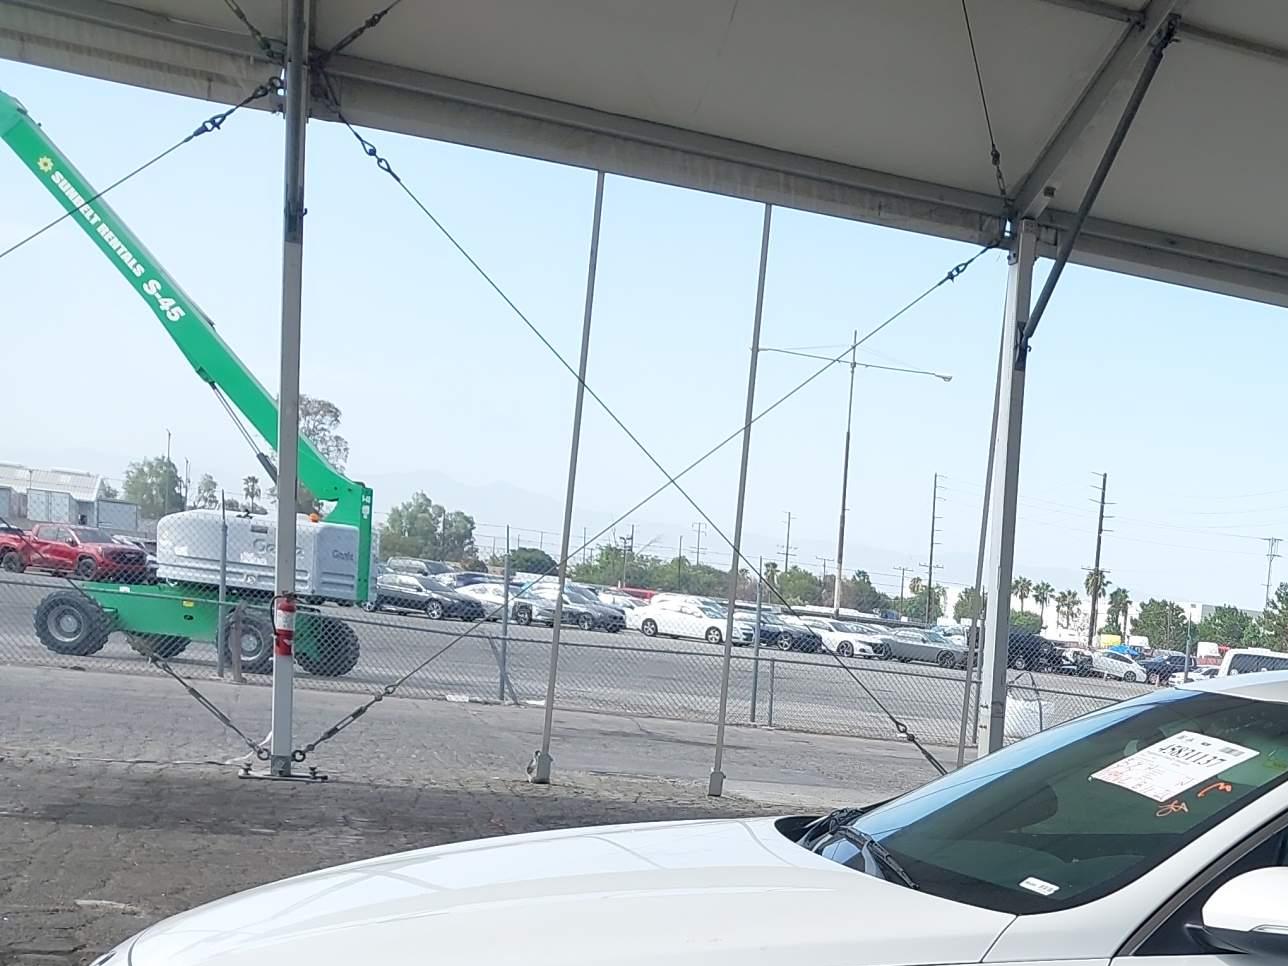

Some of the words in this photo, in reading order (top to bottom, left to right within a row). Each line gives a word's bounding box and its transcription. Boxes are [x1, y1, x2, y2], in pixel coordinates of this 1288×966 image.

[51, 171, 101, 225] SUNBELT
[96, 223, 145, 277] RENTALS
[142, 279, 186, 322] S-45
[1159, 744, 1227, 768] 45831137
